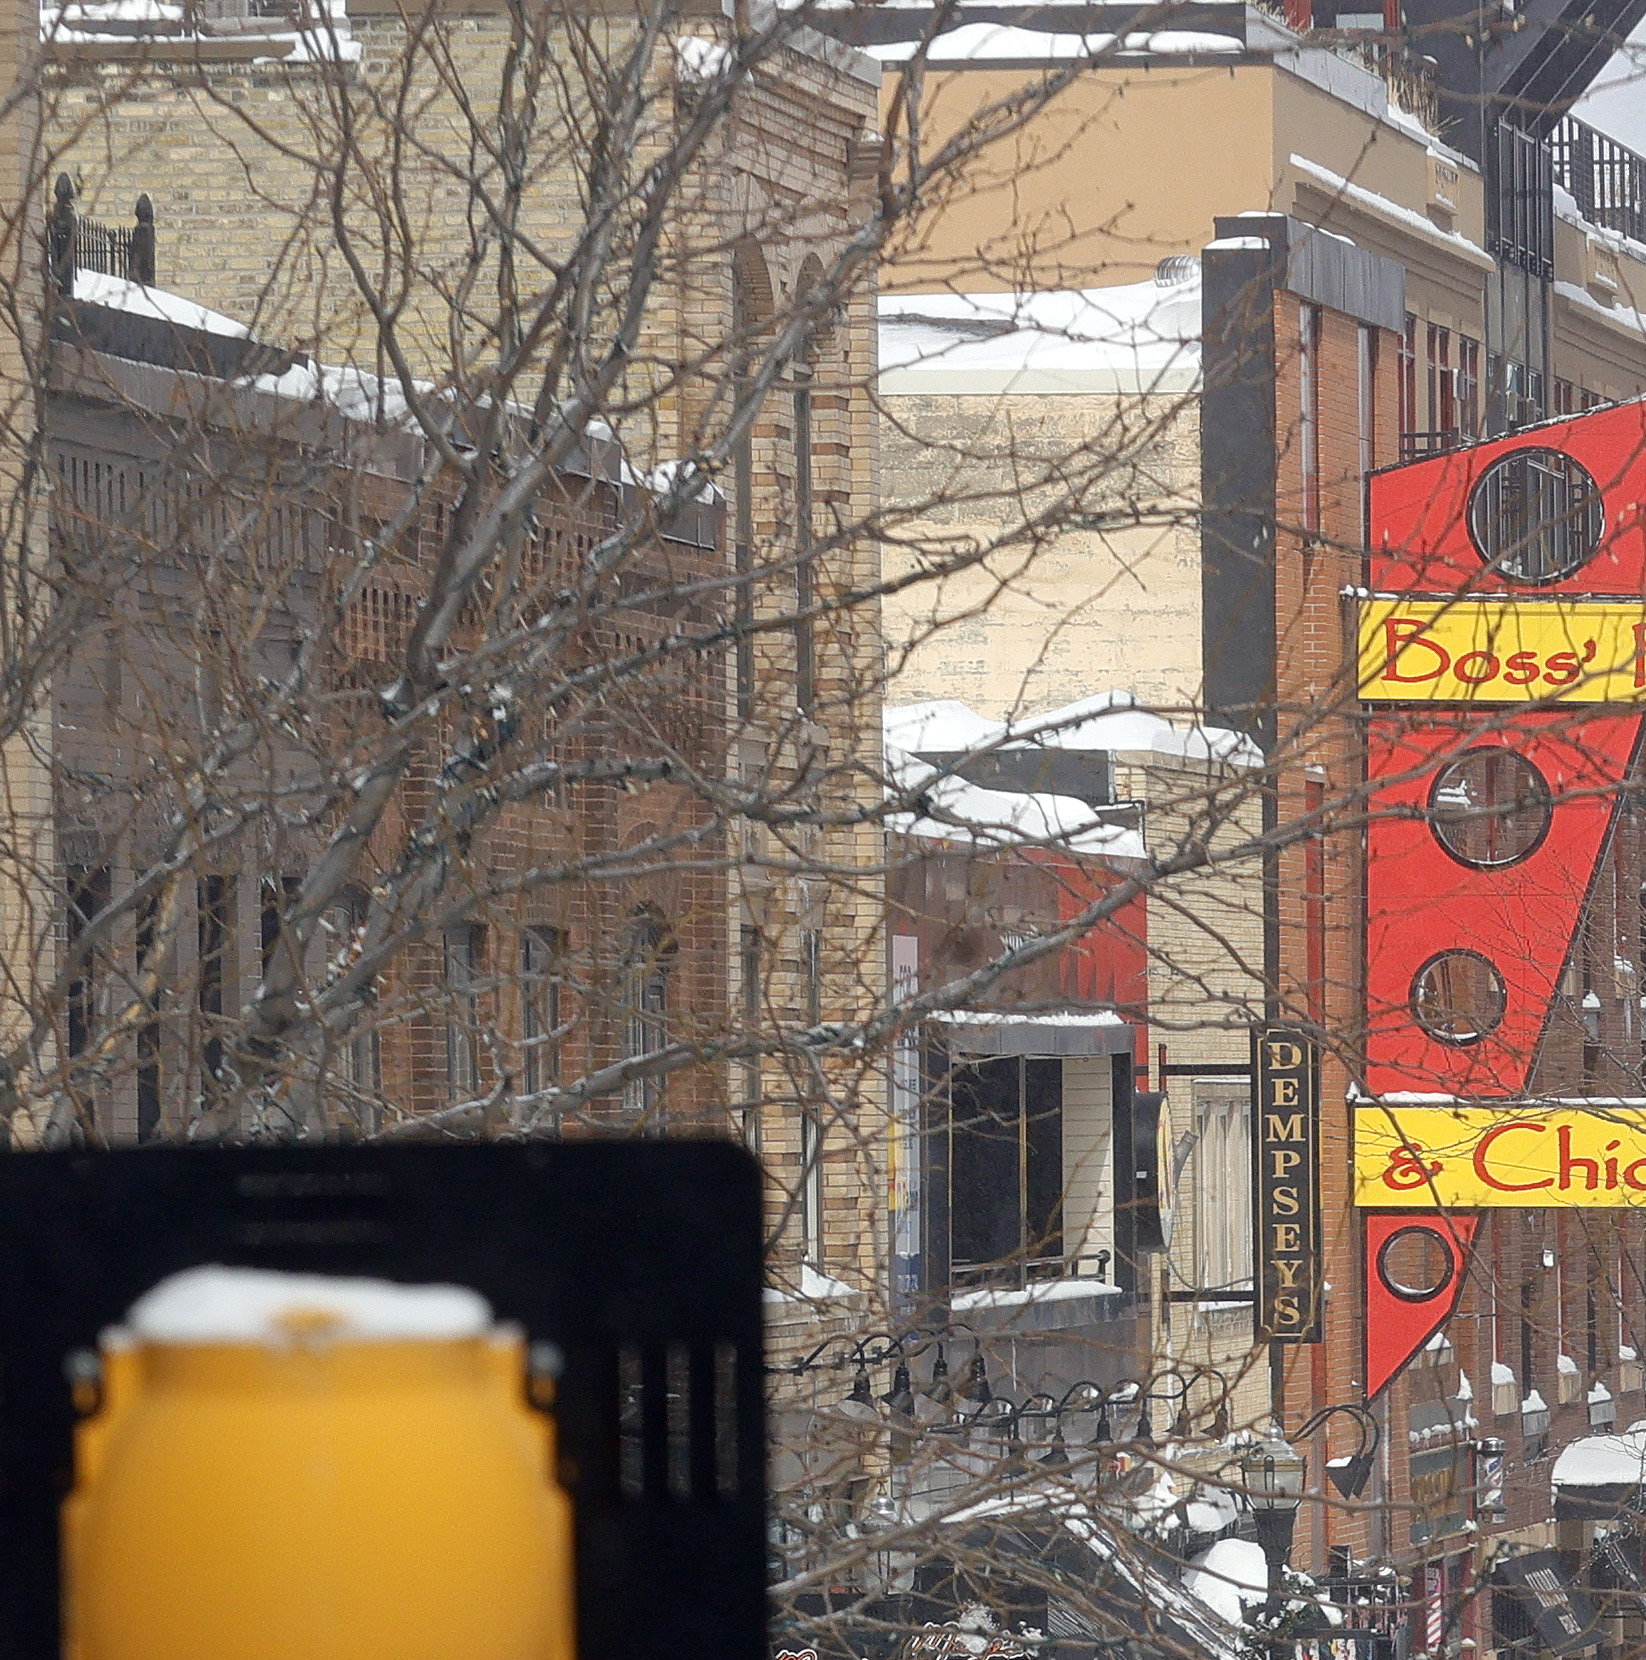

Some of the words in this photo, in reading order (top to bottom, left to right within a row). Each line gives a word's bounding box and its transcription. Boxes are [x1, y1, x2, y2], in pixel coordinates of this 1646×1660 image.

[1382, 617, 1597, 685] Boss'
[1265, 1042, 1307, 1325] DEMPSEYS
[1382, 1142, 1443, 1191] &
